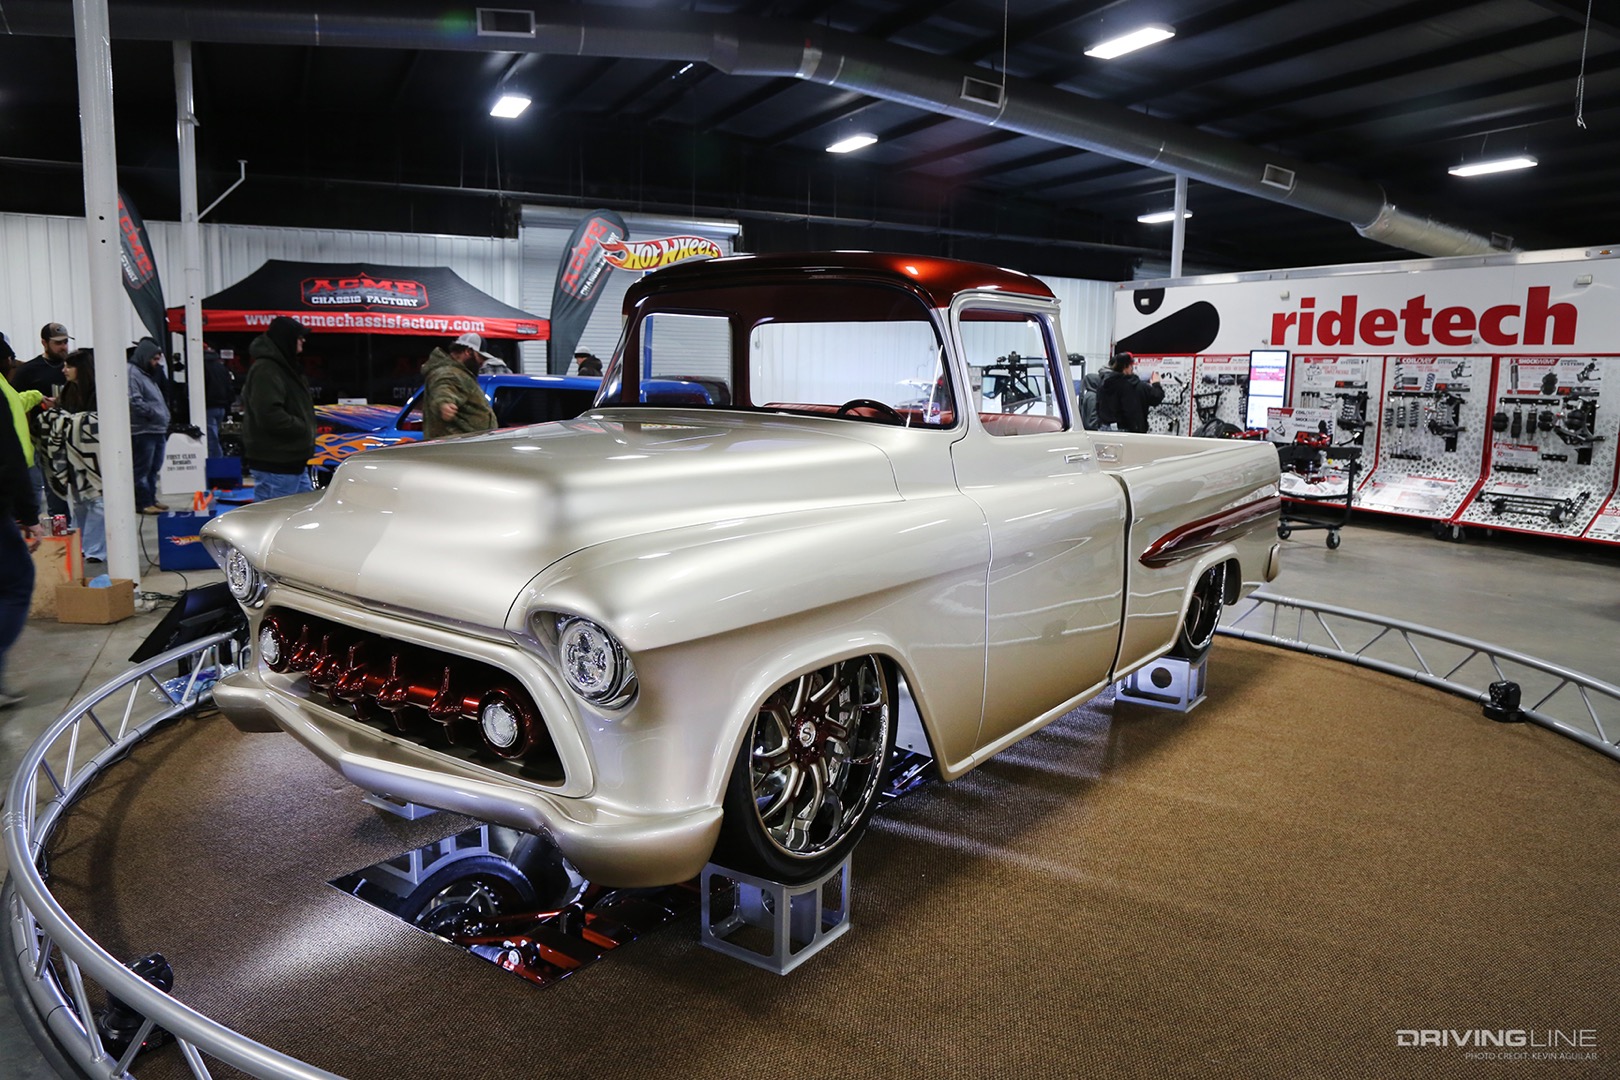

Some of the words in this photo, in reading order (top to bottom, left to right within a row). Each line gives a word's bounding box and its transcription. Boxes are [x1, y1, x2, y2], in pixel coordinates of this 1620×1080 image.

[563, 222, 608, 292] ACME
[624, 242, 662, 269] HOT
[308, 278, 418, 296] ACME
[311, 295, 361, 304] CHASSIS
[367, 296, 418, 307] FACTORY
[244, 314, 485, 332] wwacmechassisfactory.com
[1271, 285, 1578, 346] ridetech
